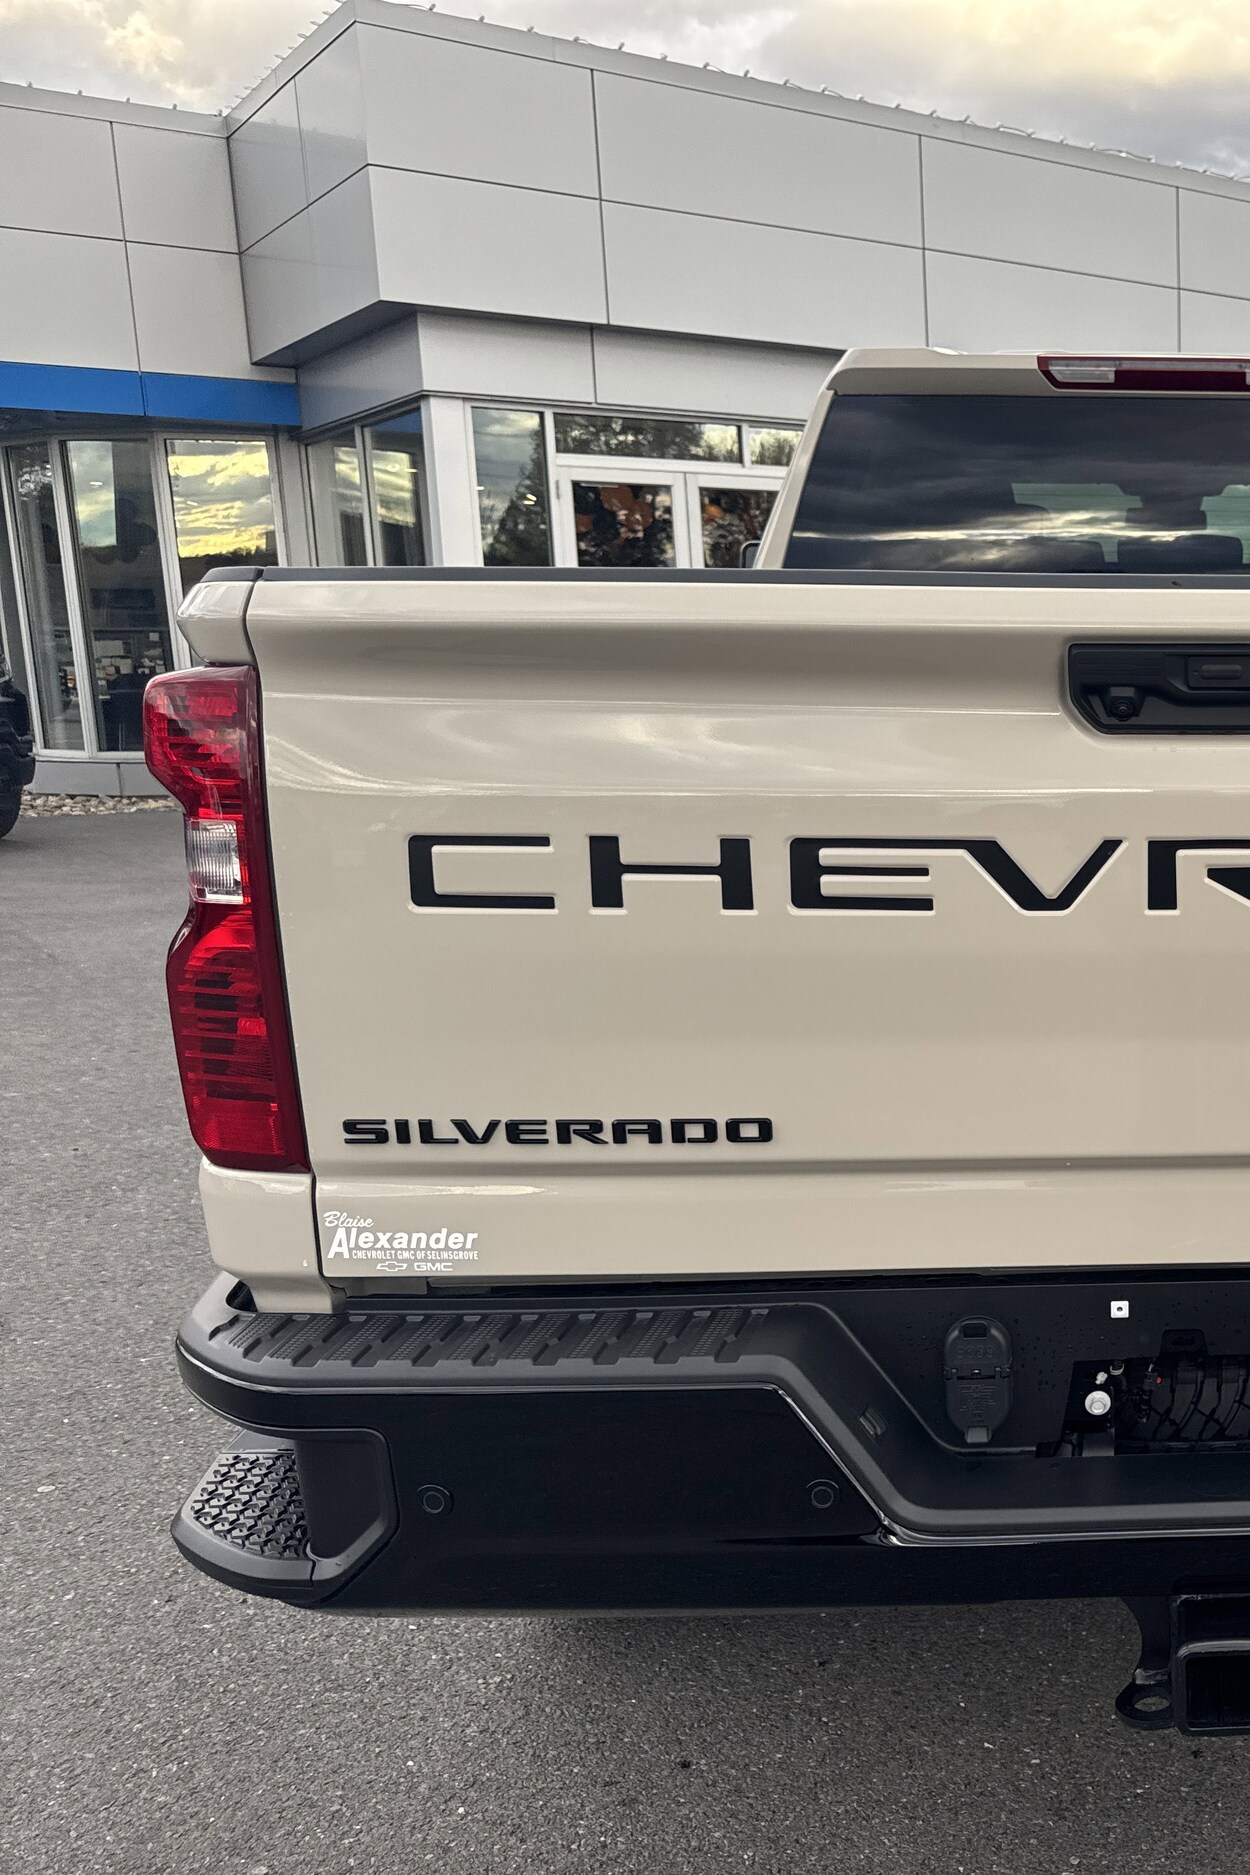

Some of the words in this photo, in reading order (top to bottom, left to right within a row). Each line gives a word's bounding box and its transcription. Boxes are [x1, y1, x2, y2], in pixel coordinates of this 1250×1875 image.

[342, 1117, 774, 1145] SILVERADO
[323, 1211, 373, 1227] Blaise
[327, 1228, 478, 1259] Alexander
[352, 1250, 395, 1259] CHEVROLET
[397, 1250, 415, 1259] GMC
[417, 1250, 426, 1259] OF
[426, 1250, 479, 1259] SELINSGROVE
[414, 1263, 453, 1271] GMC
